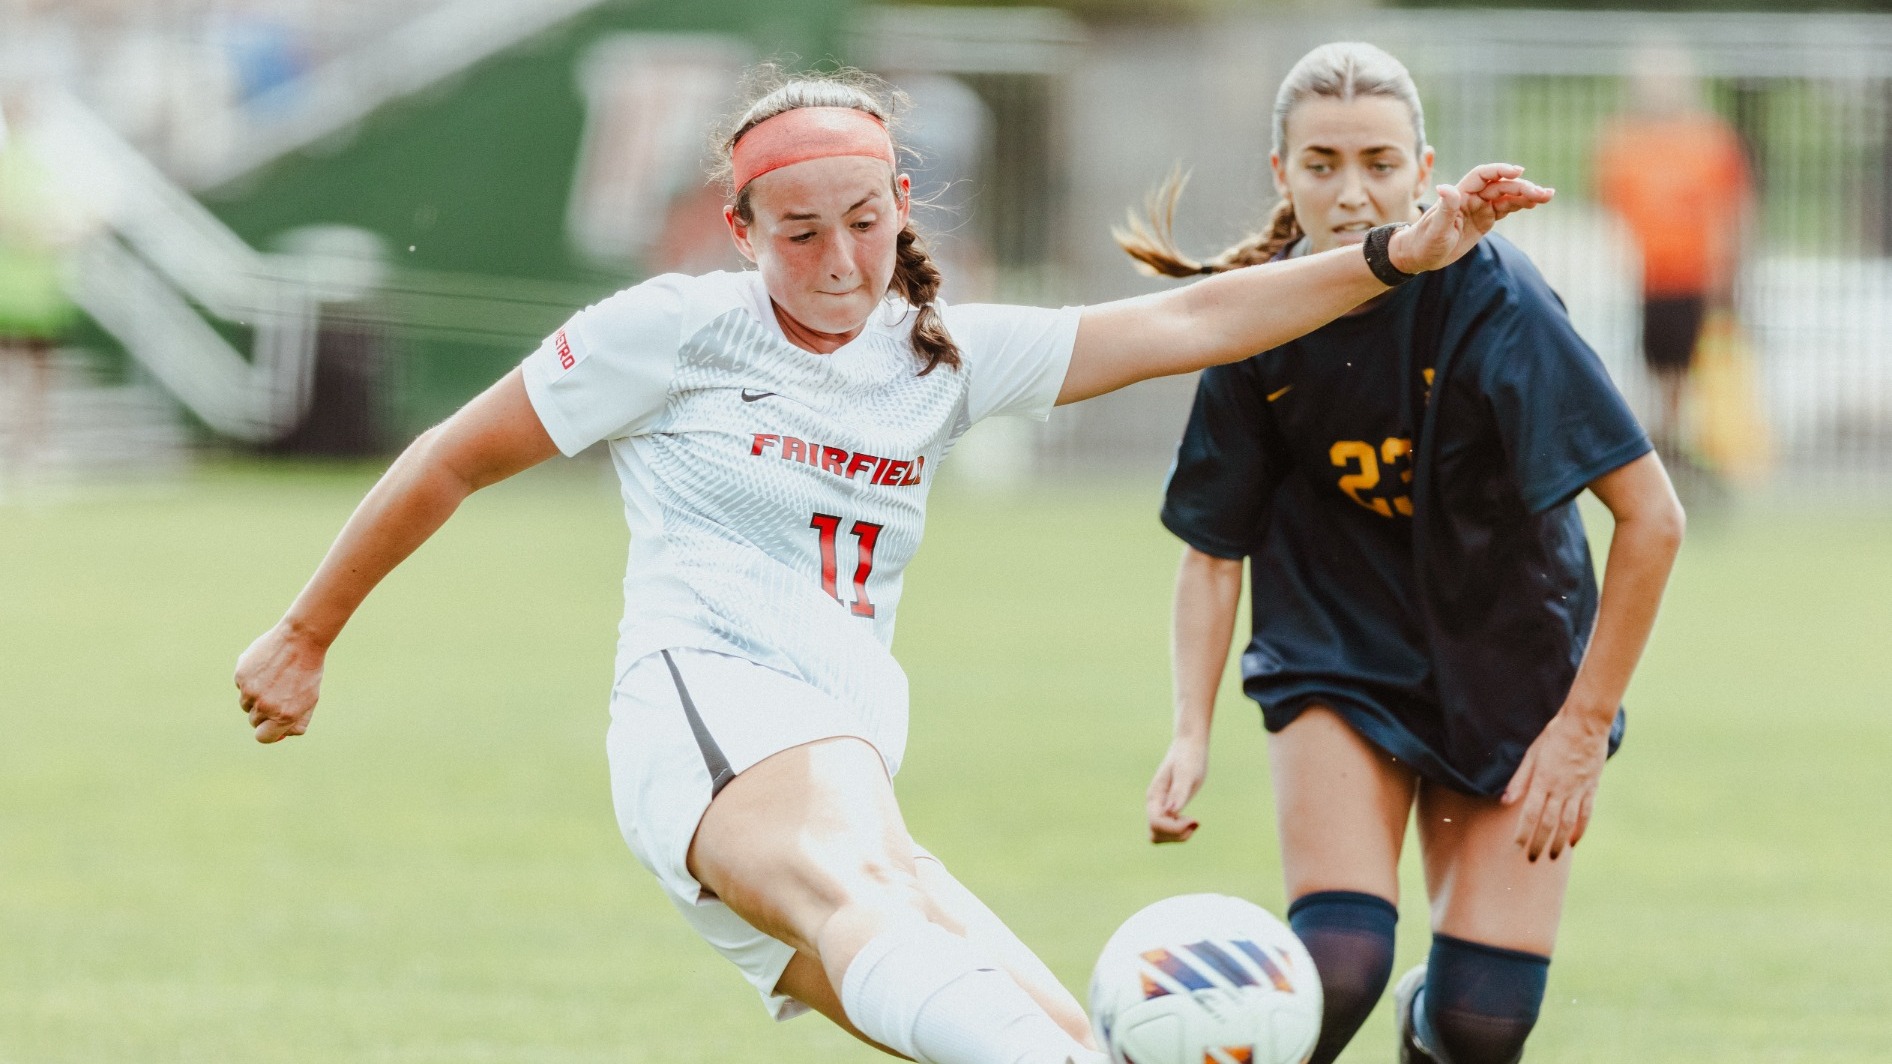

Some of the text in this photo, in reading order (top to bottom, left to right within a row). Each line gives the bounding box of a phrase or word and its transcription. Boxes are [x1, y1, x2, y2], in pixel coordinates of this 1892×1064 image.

[750, 433, 925, 486] FAIRFIELD
[1329, 437, 1414, 519] 23
[809, 512, 883, 619] 11
